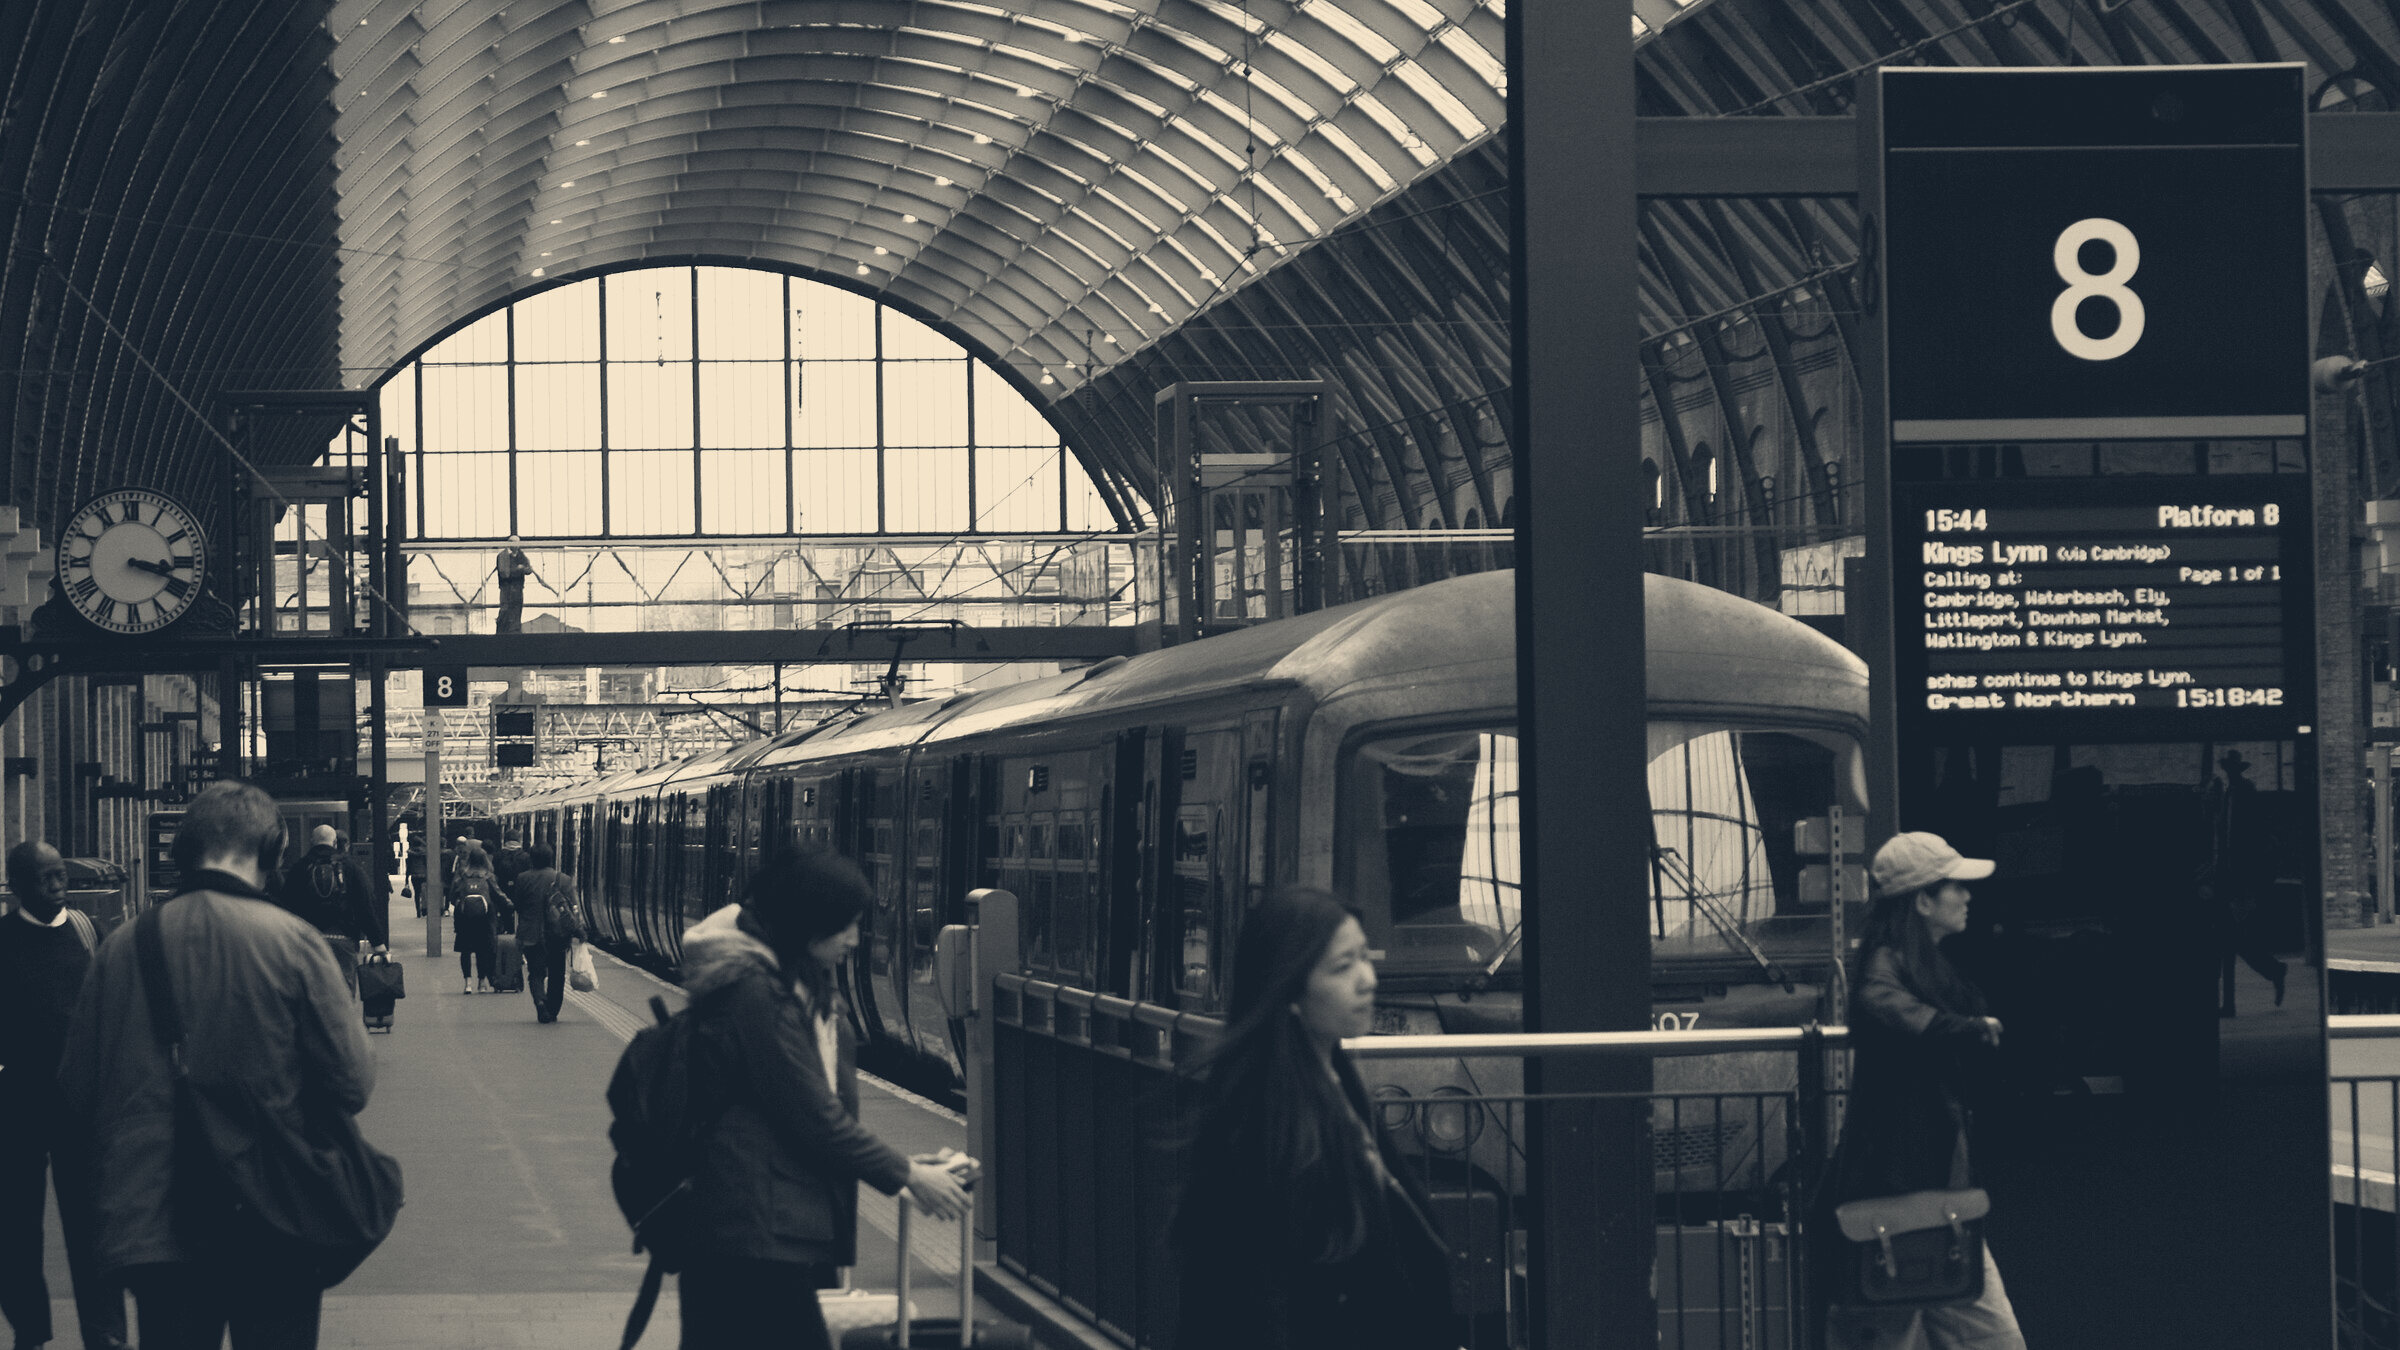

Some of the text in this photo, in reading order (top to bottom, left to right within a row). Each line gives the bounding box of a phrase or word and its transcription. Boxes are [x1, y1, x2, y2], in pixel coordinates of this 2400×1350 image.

[2051, 218, 2145, 360] 8
[1926, 509, 1987, 532] 15:44
[2158, 504, 2279, 527] Platform 8
[1923, 542, 1984, 567] Kings
[1992, 541, 2047, 566] Lynn
[1924, 570, 2022, 589] Calling at:
[2180, 566, 2280, 585] Page 1 of 1
[1924, 588, 2170, 609] Cambridge, Waterbeach, Ely,
[1925, 609, 2169, 630] Littleport, Downham Market,
[1925, 630, 2147, 650] Watlington & Kings Lynn.
[438, 676, 452, 697] 8
[1983, 672, 2061, 688] continue
[2066, 671, 2087, 686] to
[2092, 671, 2143, 688] Kings
[2148, 670, 2195, 687] Lynn.
[1927, 688, 2283, 710] Great Northern 15:18:42
[427, 730, 440, 738] 271
